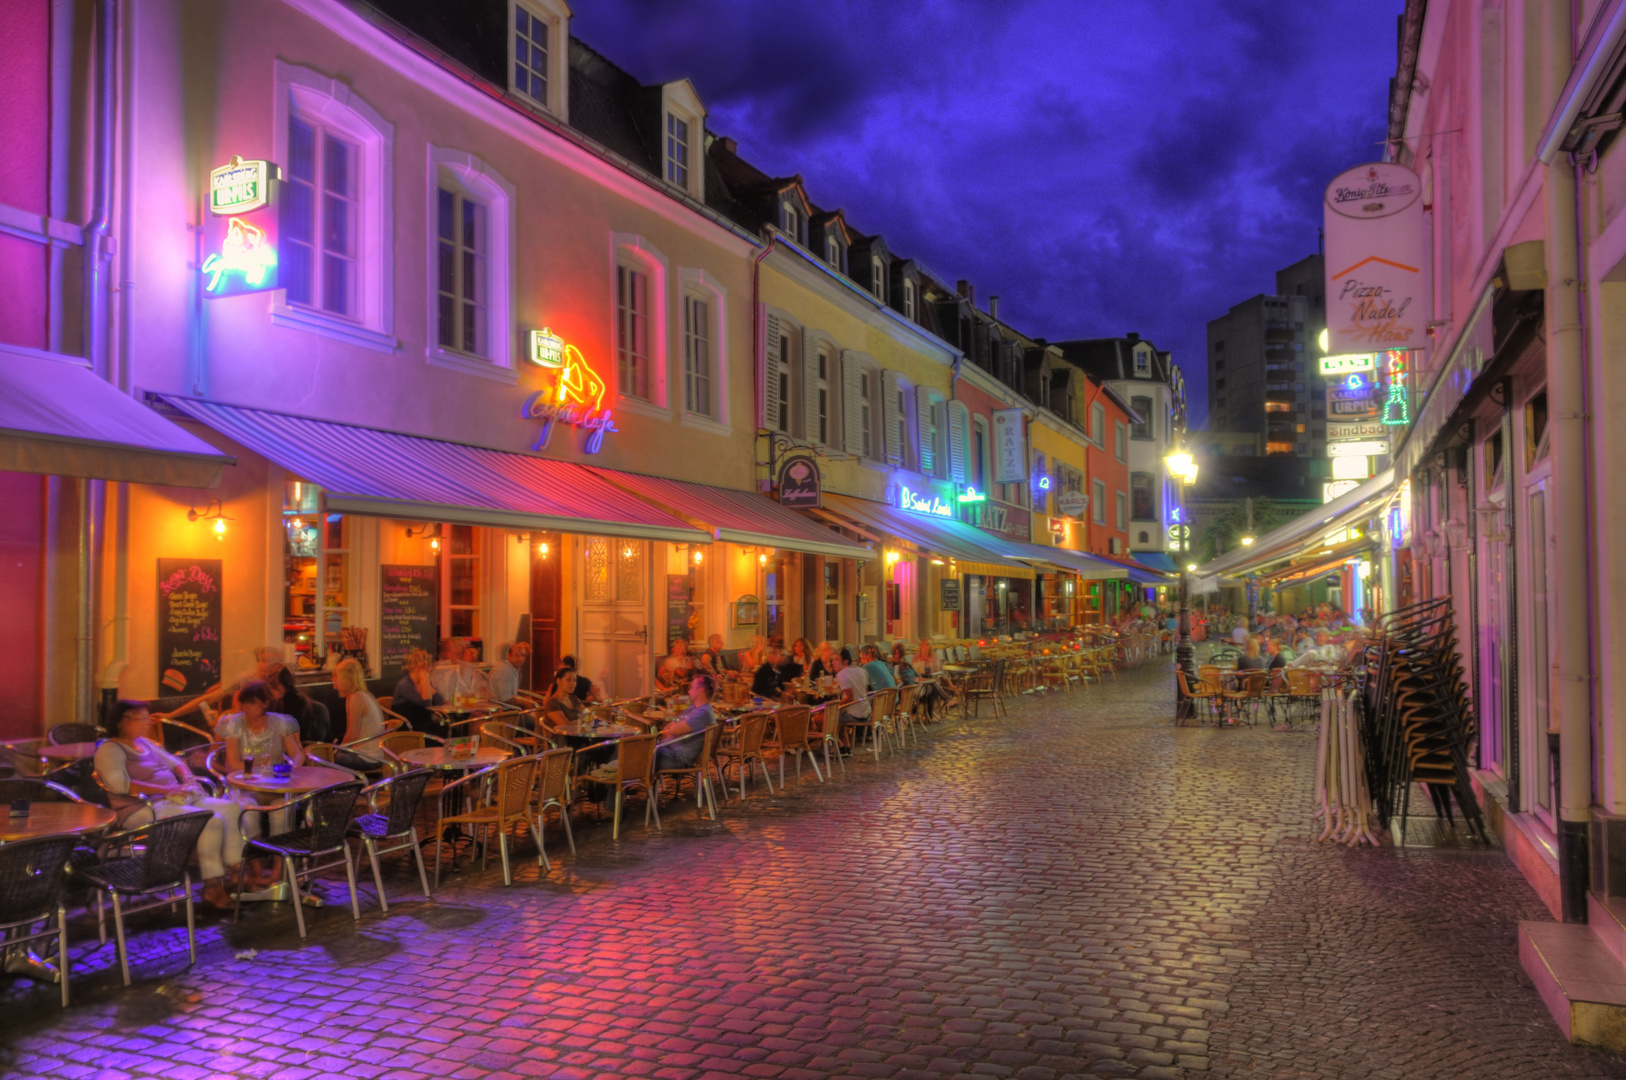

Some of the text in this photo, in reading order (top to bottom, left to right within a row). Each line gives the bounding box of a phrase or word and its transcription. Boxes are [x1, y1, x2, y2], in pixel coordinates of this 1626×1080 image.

[1339, 280, 1392, 300] Pizza-
[1351, 297, 1413, 322] Nudel
[1330, 425, 1385, 437] Sindbad
[188, 565, 216, 593] Day
